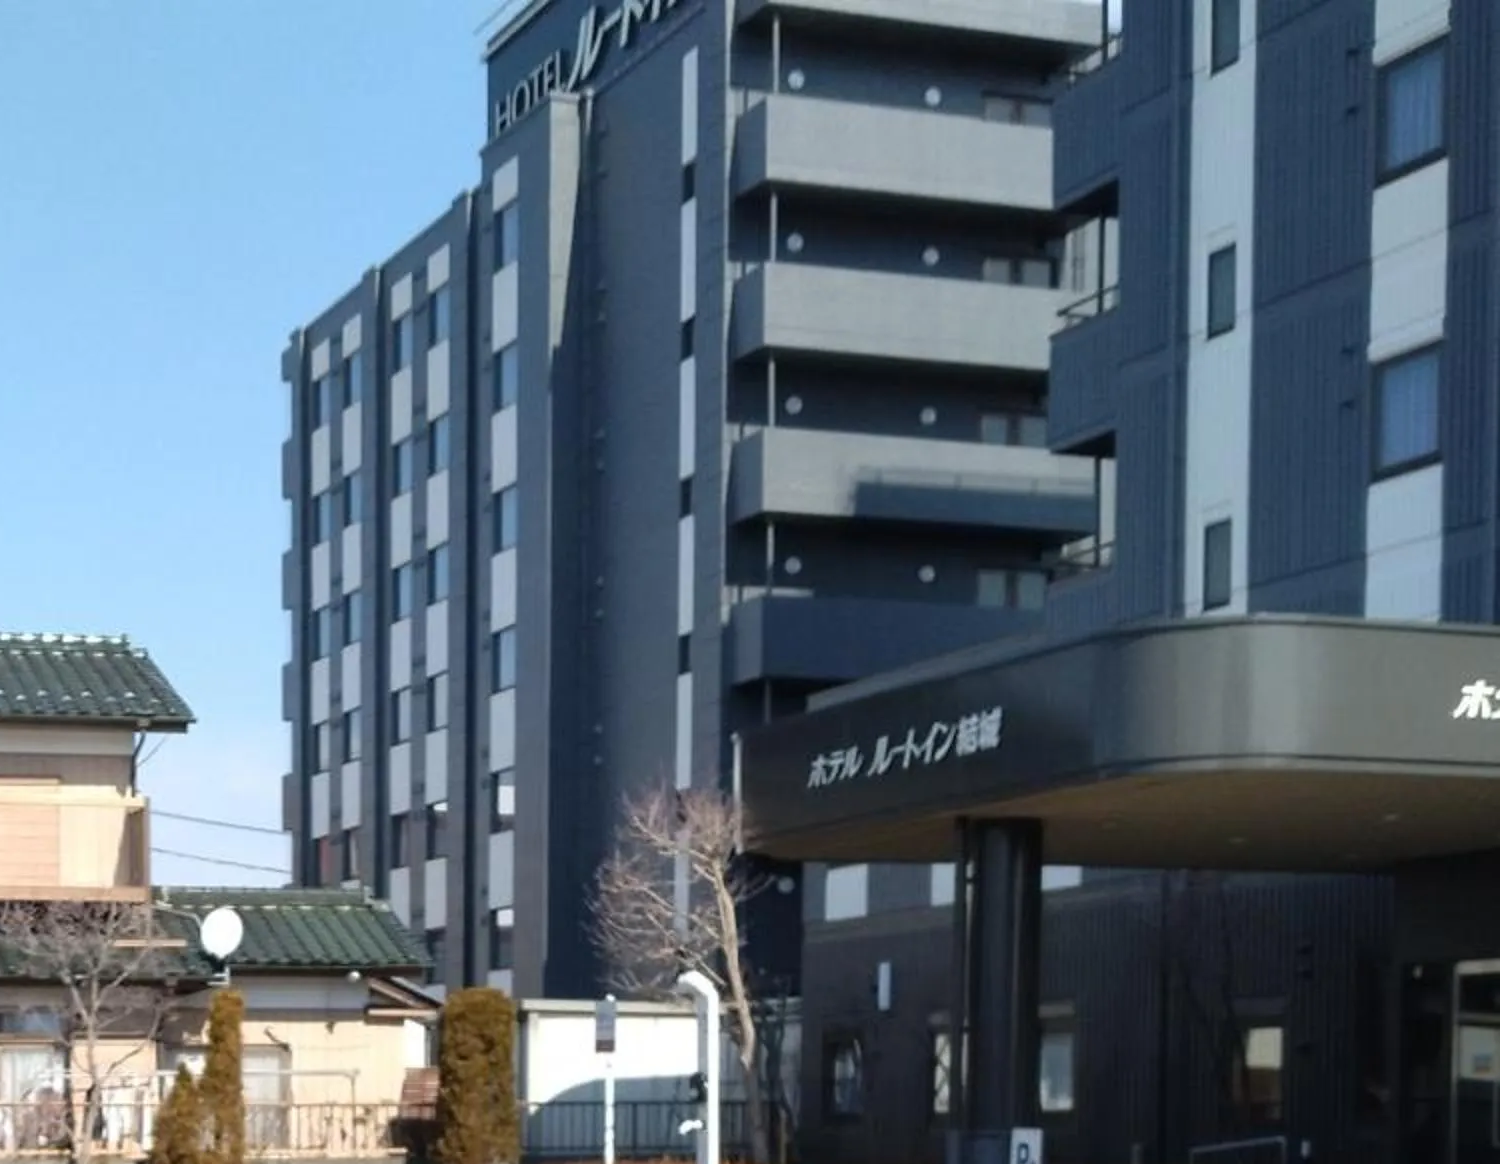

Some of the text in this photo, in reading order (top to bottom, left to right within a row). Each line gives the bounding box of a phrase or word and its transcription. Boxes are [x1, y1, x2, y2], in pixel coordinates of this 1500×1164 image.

[566, 0, 676, 92] ルート
[494, 50, 566, 138] HOTEL
[1452, 679, 1500, 720] ホ
[807, 746, 864, 788] ホテル
